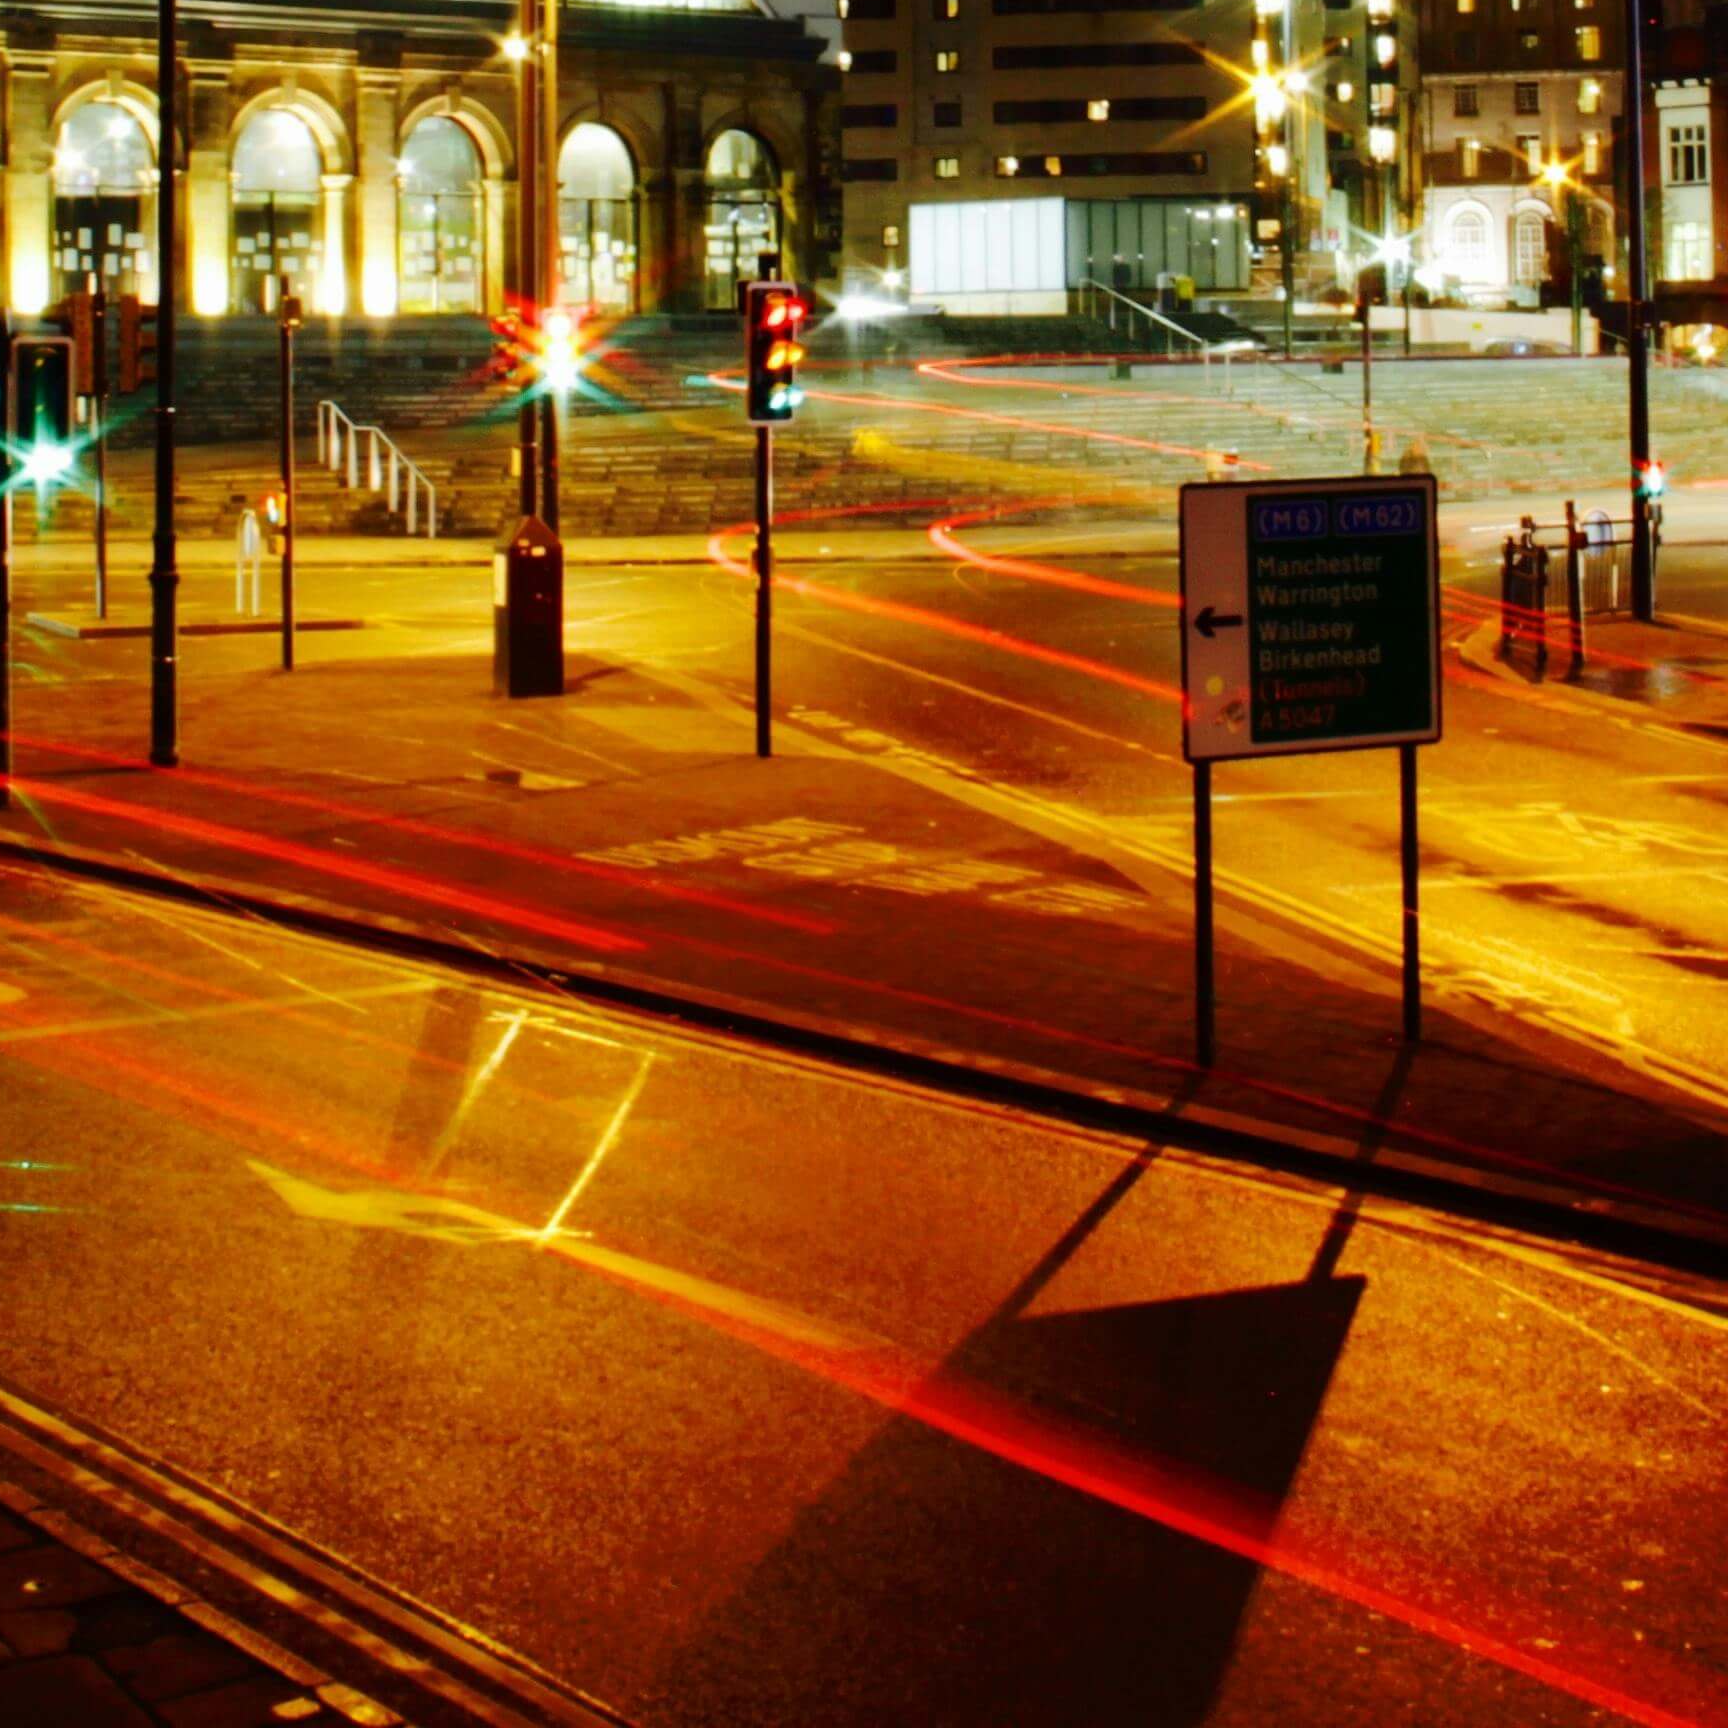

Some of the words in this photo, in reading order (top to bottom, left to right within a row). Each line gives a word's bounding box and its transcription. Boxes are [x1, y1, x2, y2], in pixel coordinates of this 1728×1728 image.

[1258, 554, 1383, 577] Manchester
[1258, 582, 1378, 607] Warrington
[1259, 619, 1355, 642] Wallasey
[1259, 644, 1382, 672] Birkenhead
